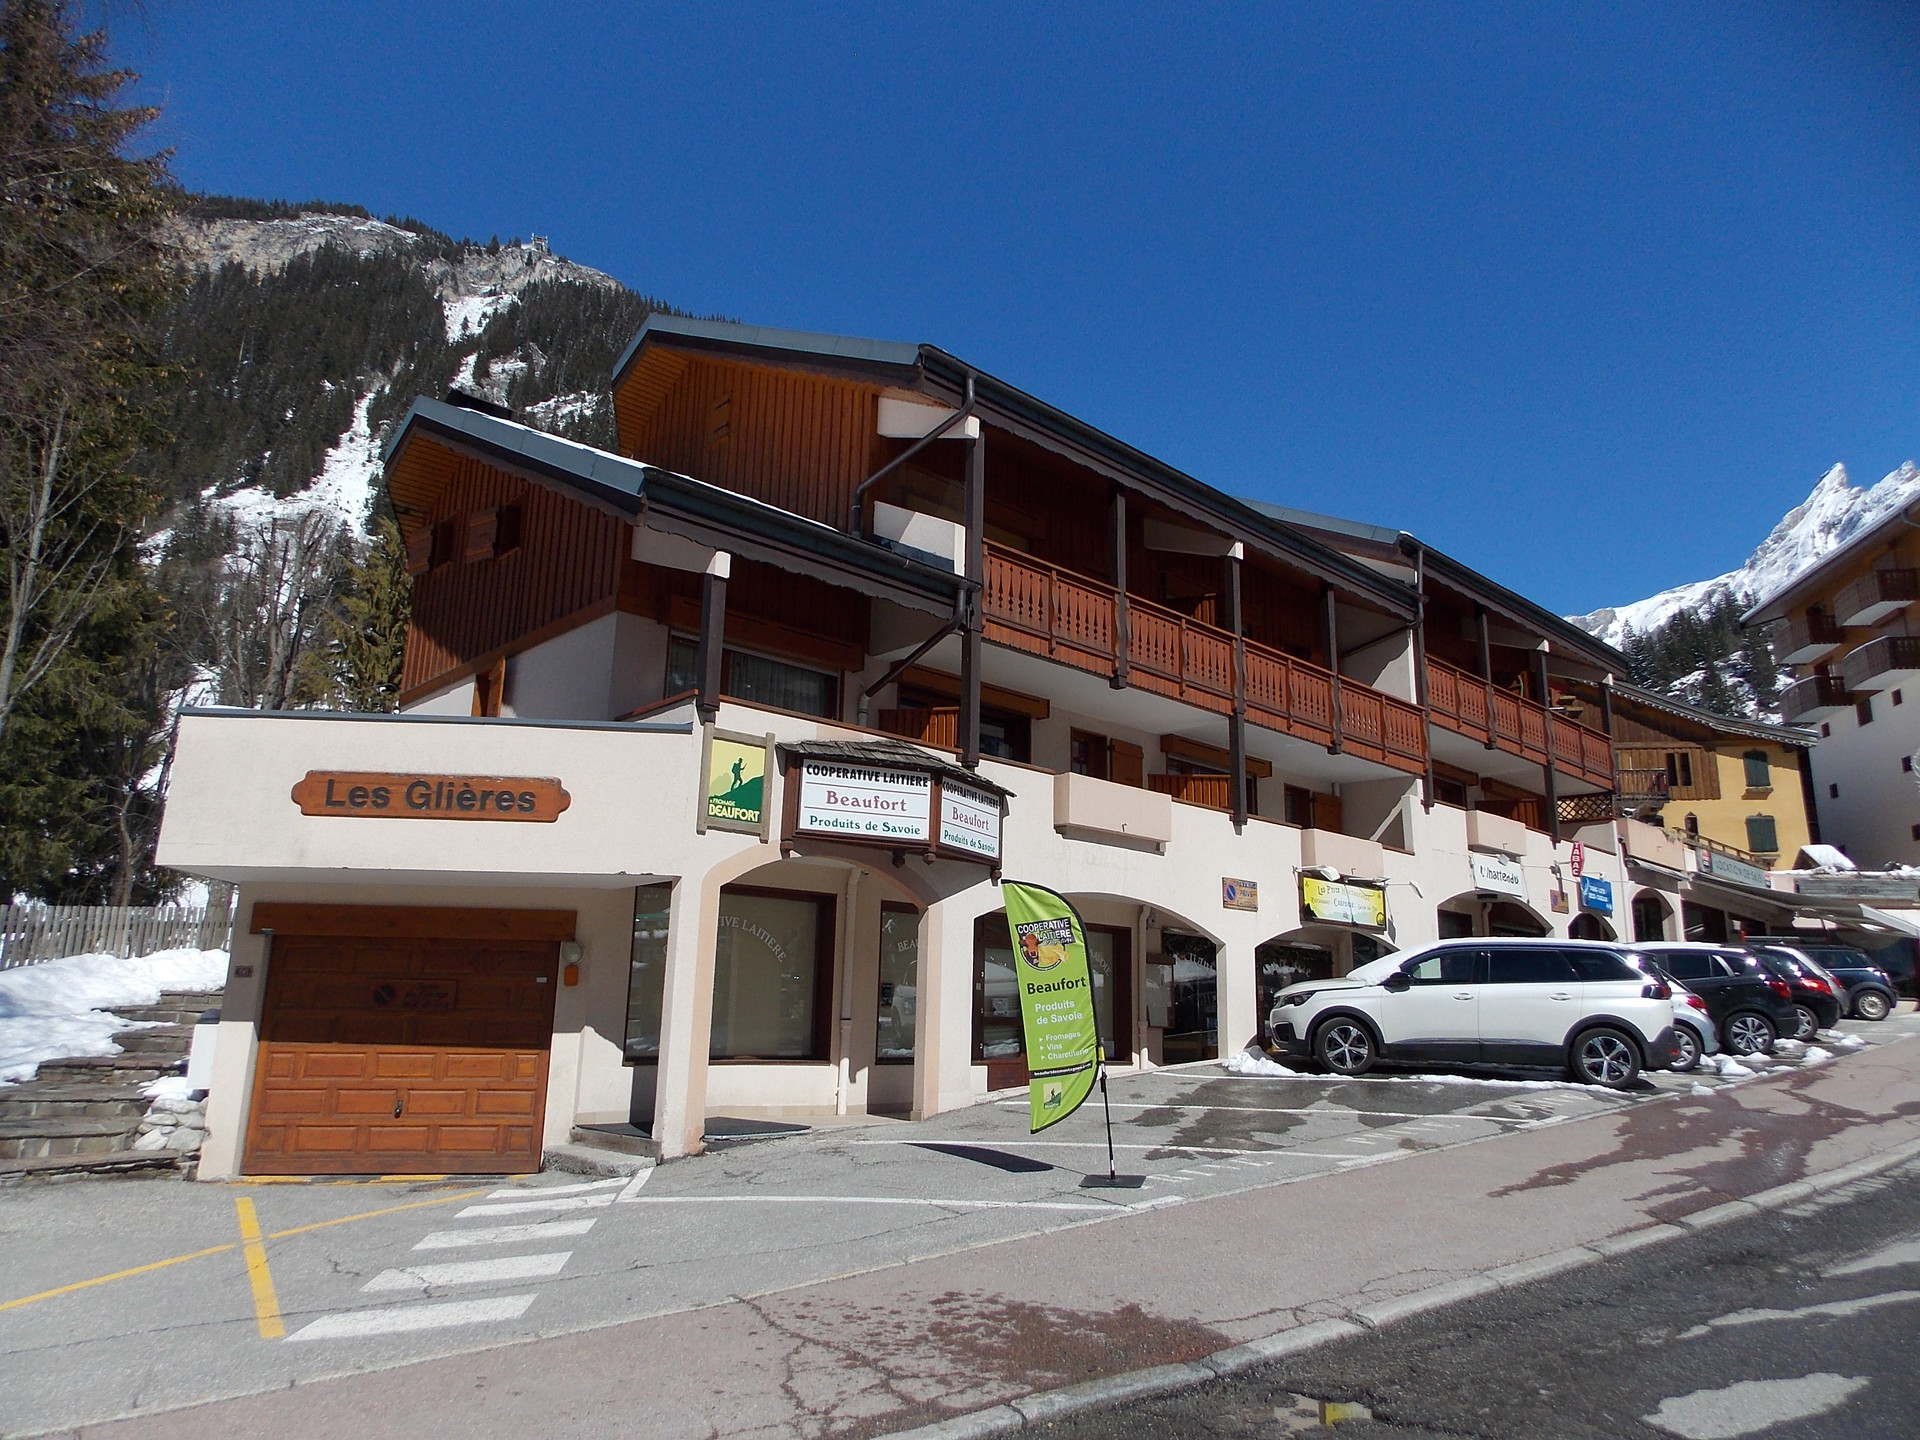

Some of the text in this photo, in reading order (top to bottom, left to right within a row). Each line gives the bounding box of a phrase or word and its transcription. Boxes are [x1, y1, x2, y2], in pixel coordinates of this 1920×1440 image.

[806, 764, 929, 787] COOPERATIVE LAITIERE
[325, 779, 536, 813] Les Glières
[826, 790, 907, 812] Beaufort
[942, 780, 999, 809] COOPERATIVE LAITIERE
[708, 803, 760, 822] BEAUFORT
[952, 807, 989, 831] Beaufort
[810, 815, 920, 835] Produits de Savoie
[944, 830, 995, 853] Produits de Savoie
[1573, 841, 1581, 875] TABAC
[1018, 919, 1070, 934] COOPERATIVE
[1037, 929, 1071, 941] LAITIERE
[742, 919, 787, 962] LAITIERE
[1027, 977, 1086, 995] Beaufort
[1035, 1000, 1075, 1012] Produits
[1037, 1012, 1083, 1024] de Savoie
[1045, 1032, 1080, 1041] Fromages
[1047, 1043, 1062, 1051] Vins
